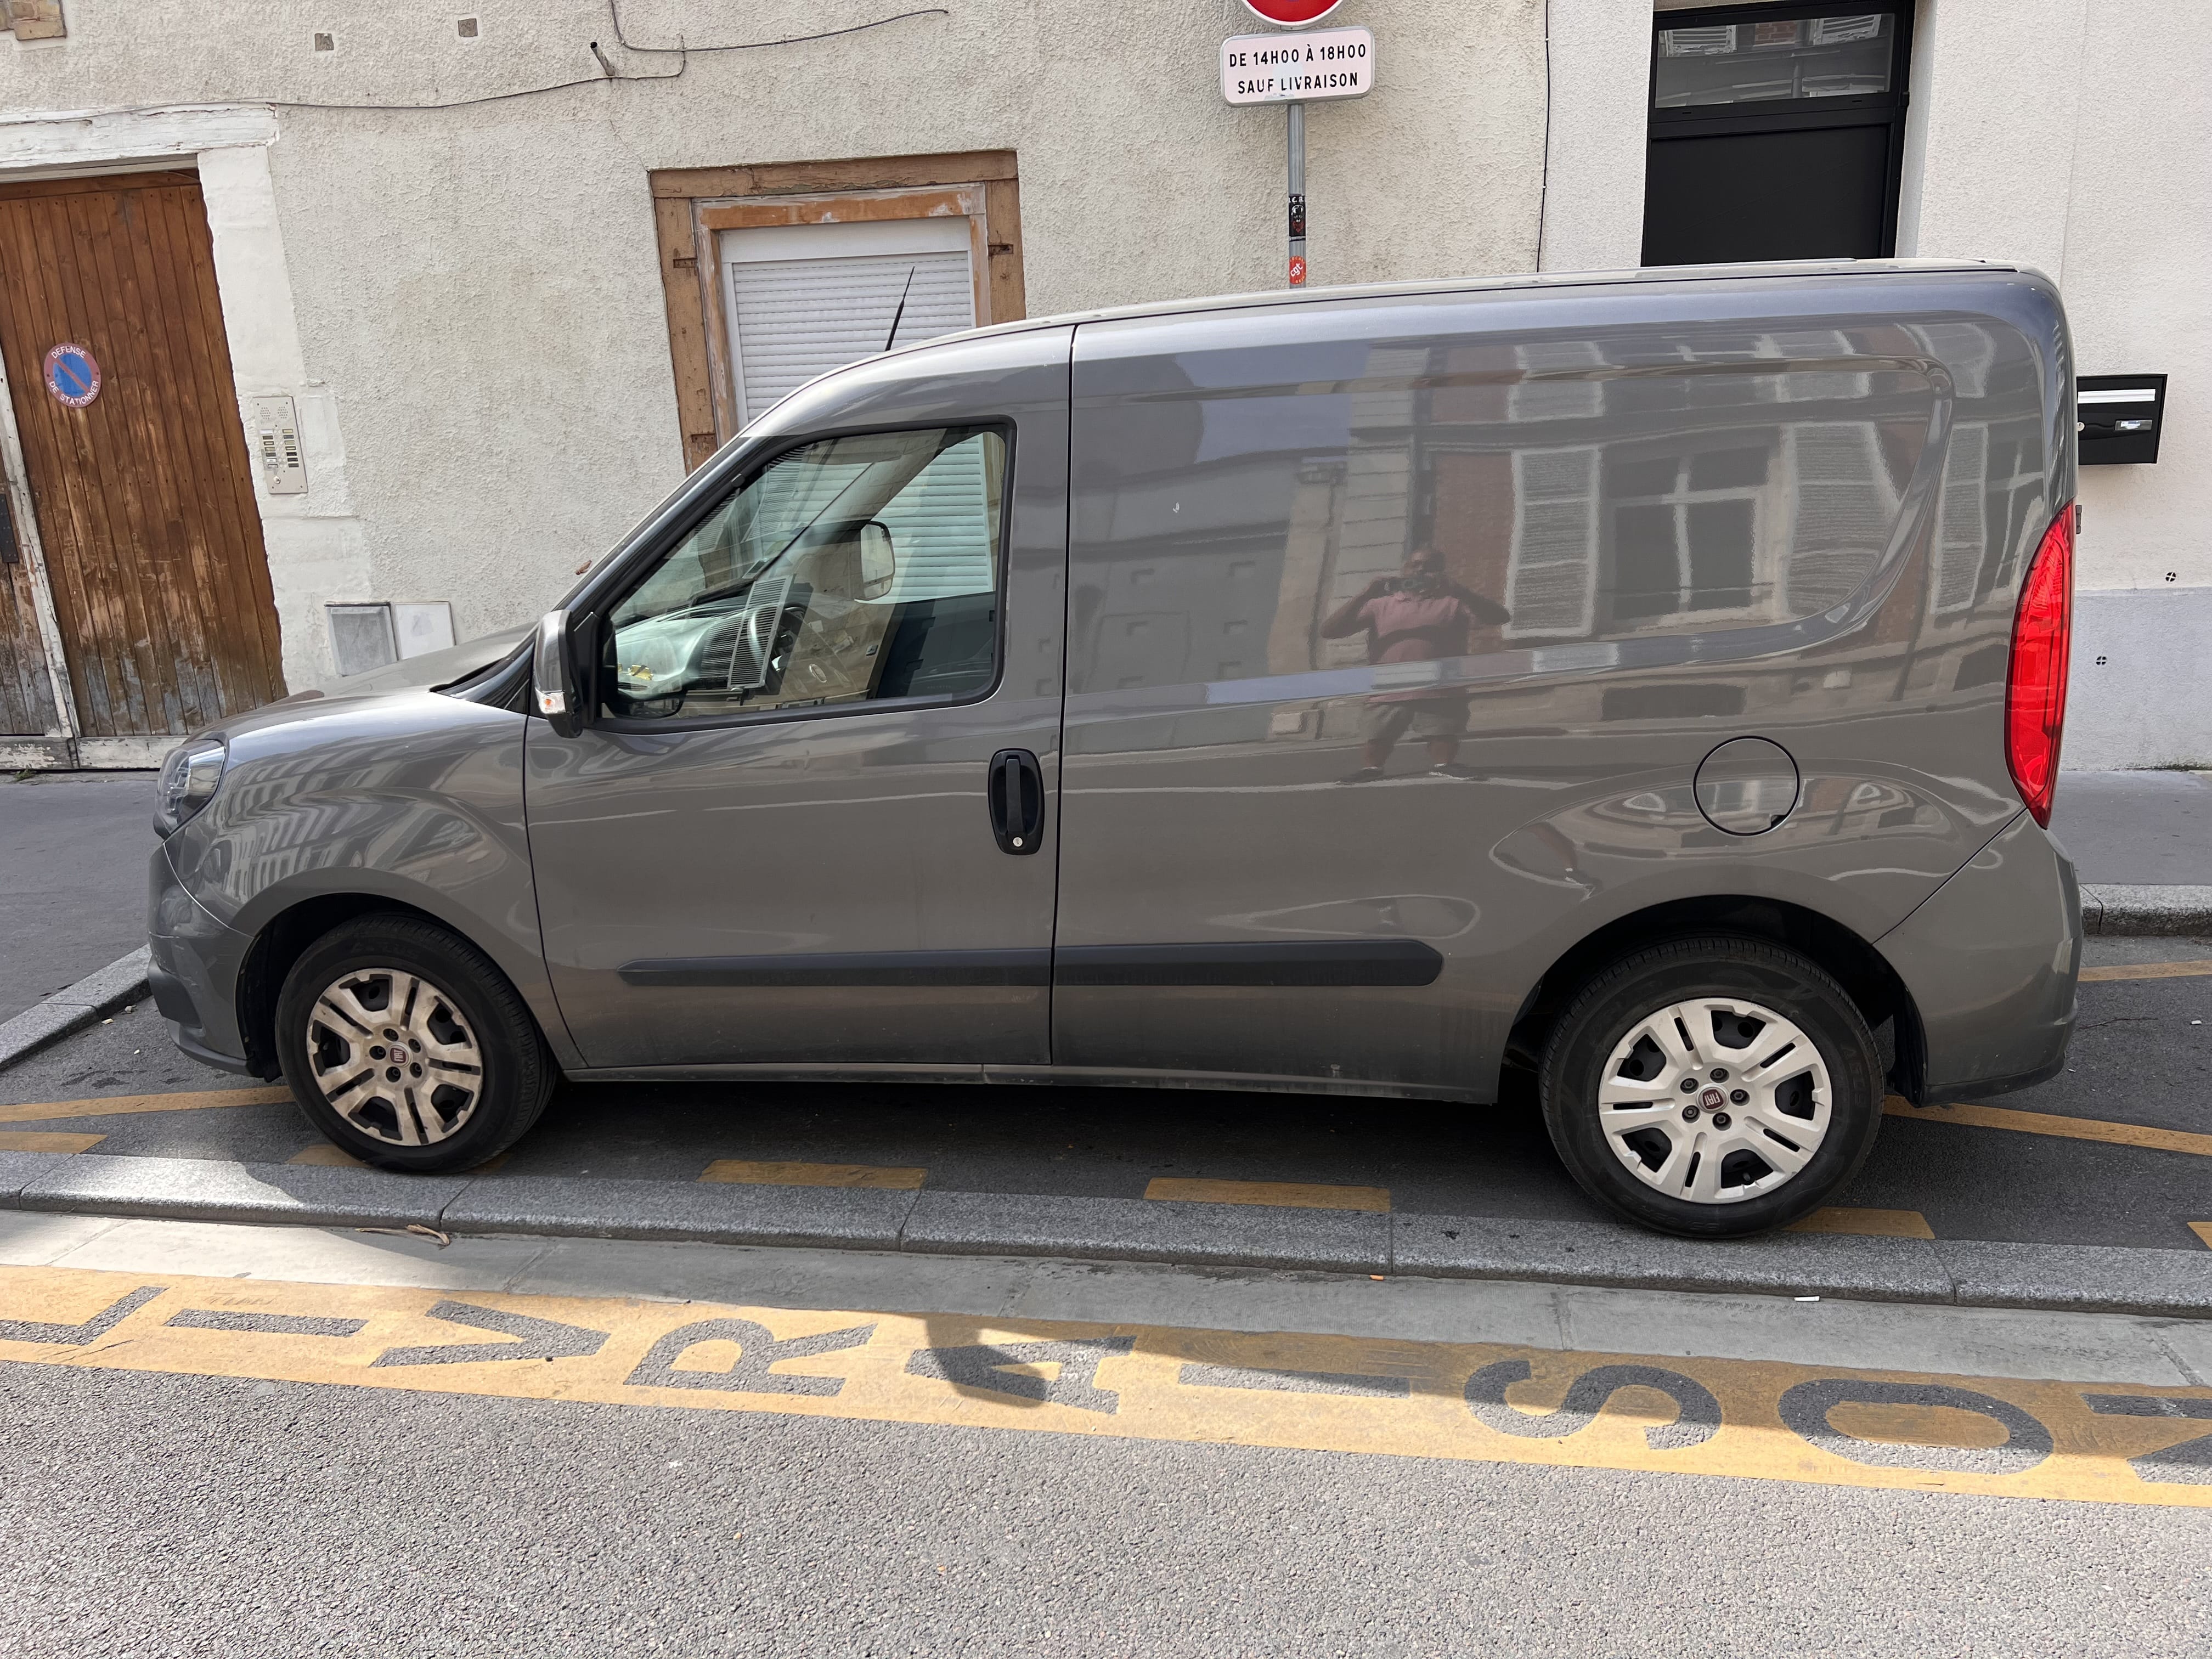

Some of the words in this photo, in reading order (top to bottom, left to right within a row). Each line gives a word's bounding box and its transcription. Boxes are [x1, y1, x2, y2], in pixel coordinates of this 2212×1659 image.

[1229, 53, 1247, 67] DE
[1253, 49, 1300, 66] 14H00
[1306, 44, 1314, 62] À
[1320, 43, 1366, 61] 18H00
[1238, 78, 1274, 94] SAUF
[1280, 72, 1358, 91] LIVRAISON
[1290, 263, 1304, 277] cgt
[51, 345, 86, 359] DEFENSE
[49, 381, 60, 393] DE
[59, 380, 99, 405] STATIONNER
[393, 1048, 404, 1062] FIAT
[1704, 1092, 1721, 1106] FIAT
